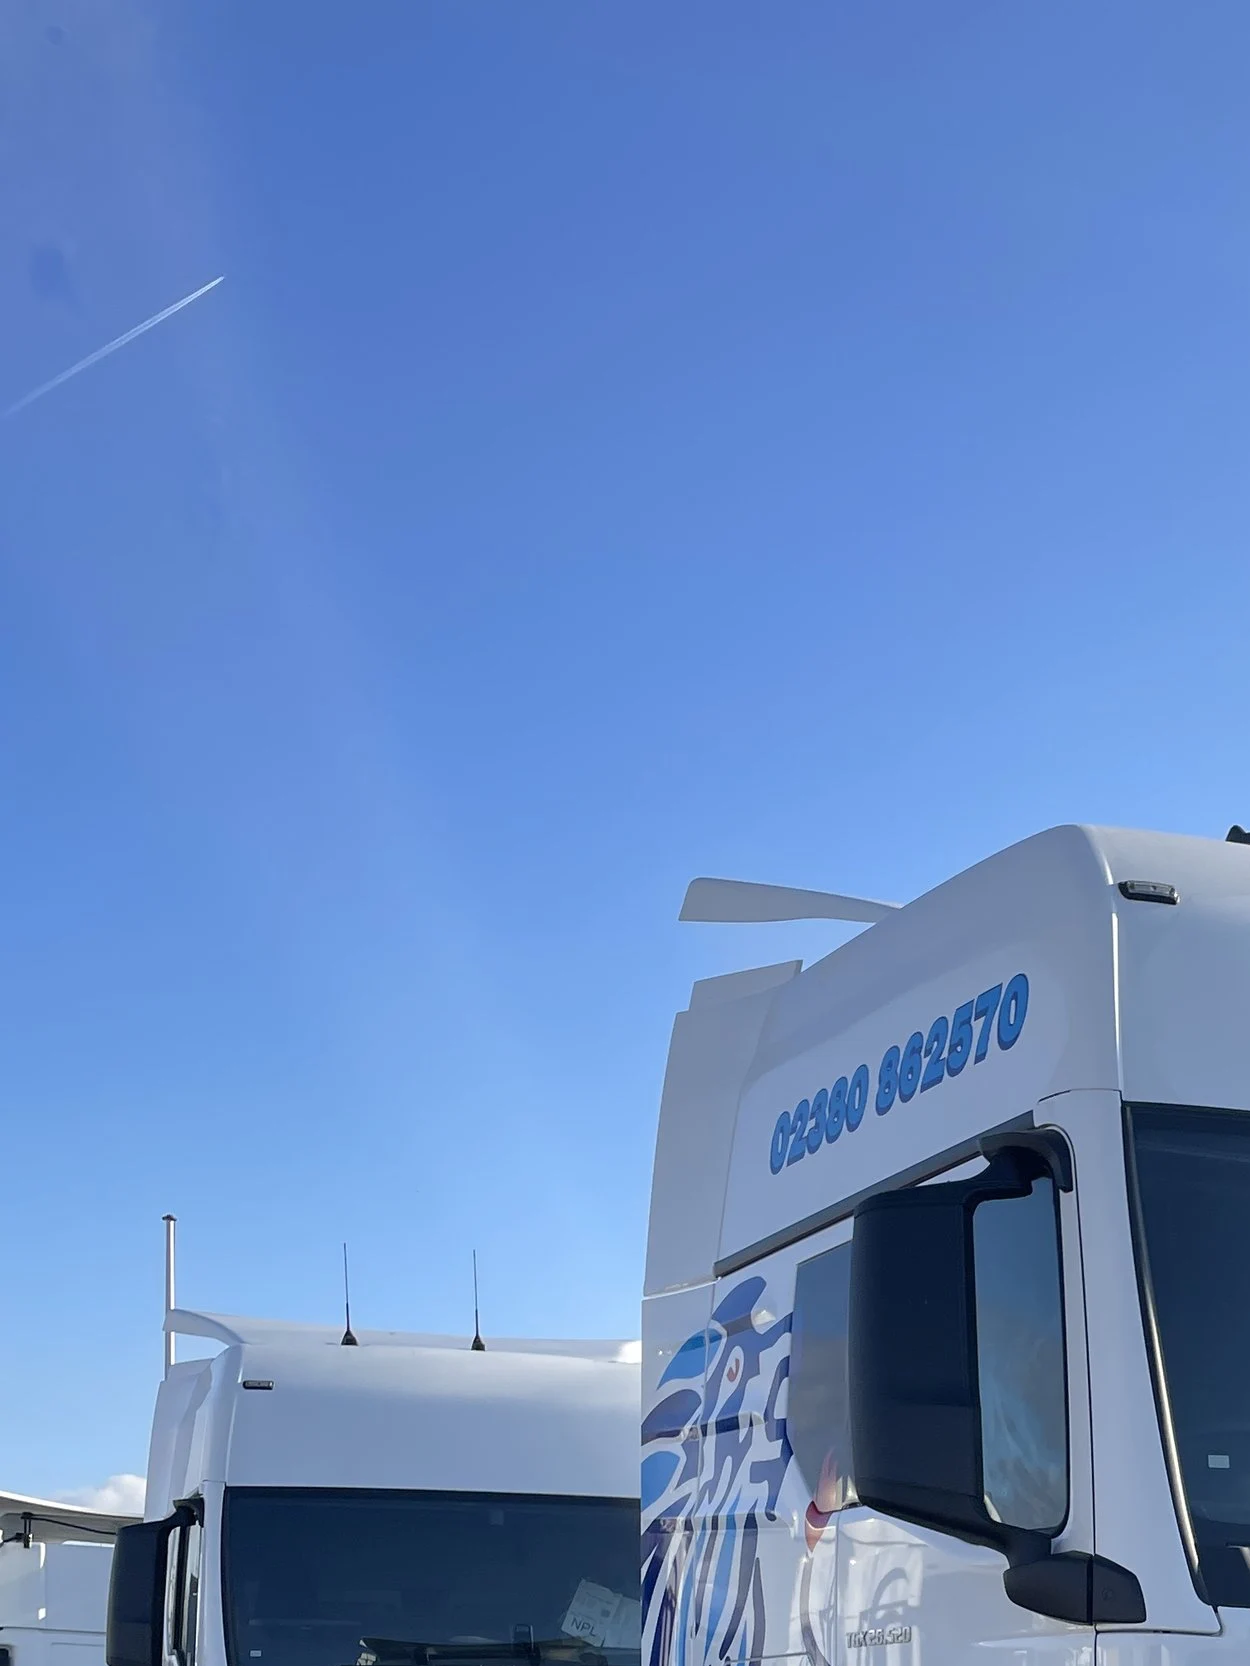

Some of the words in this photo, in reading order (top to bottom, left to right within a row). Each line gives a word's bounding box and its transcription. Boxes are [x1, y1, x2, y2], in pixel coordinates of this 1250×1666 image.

[770, 1064, 869, 1175] 02380
[875, 973, 1029, 1116] 862570
[571, 1618, 597, 1637] NPL
